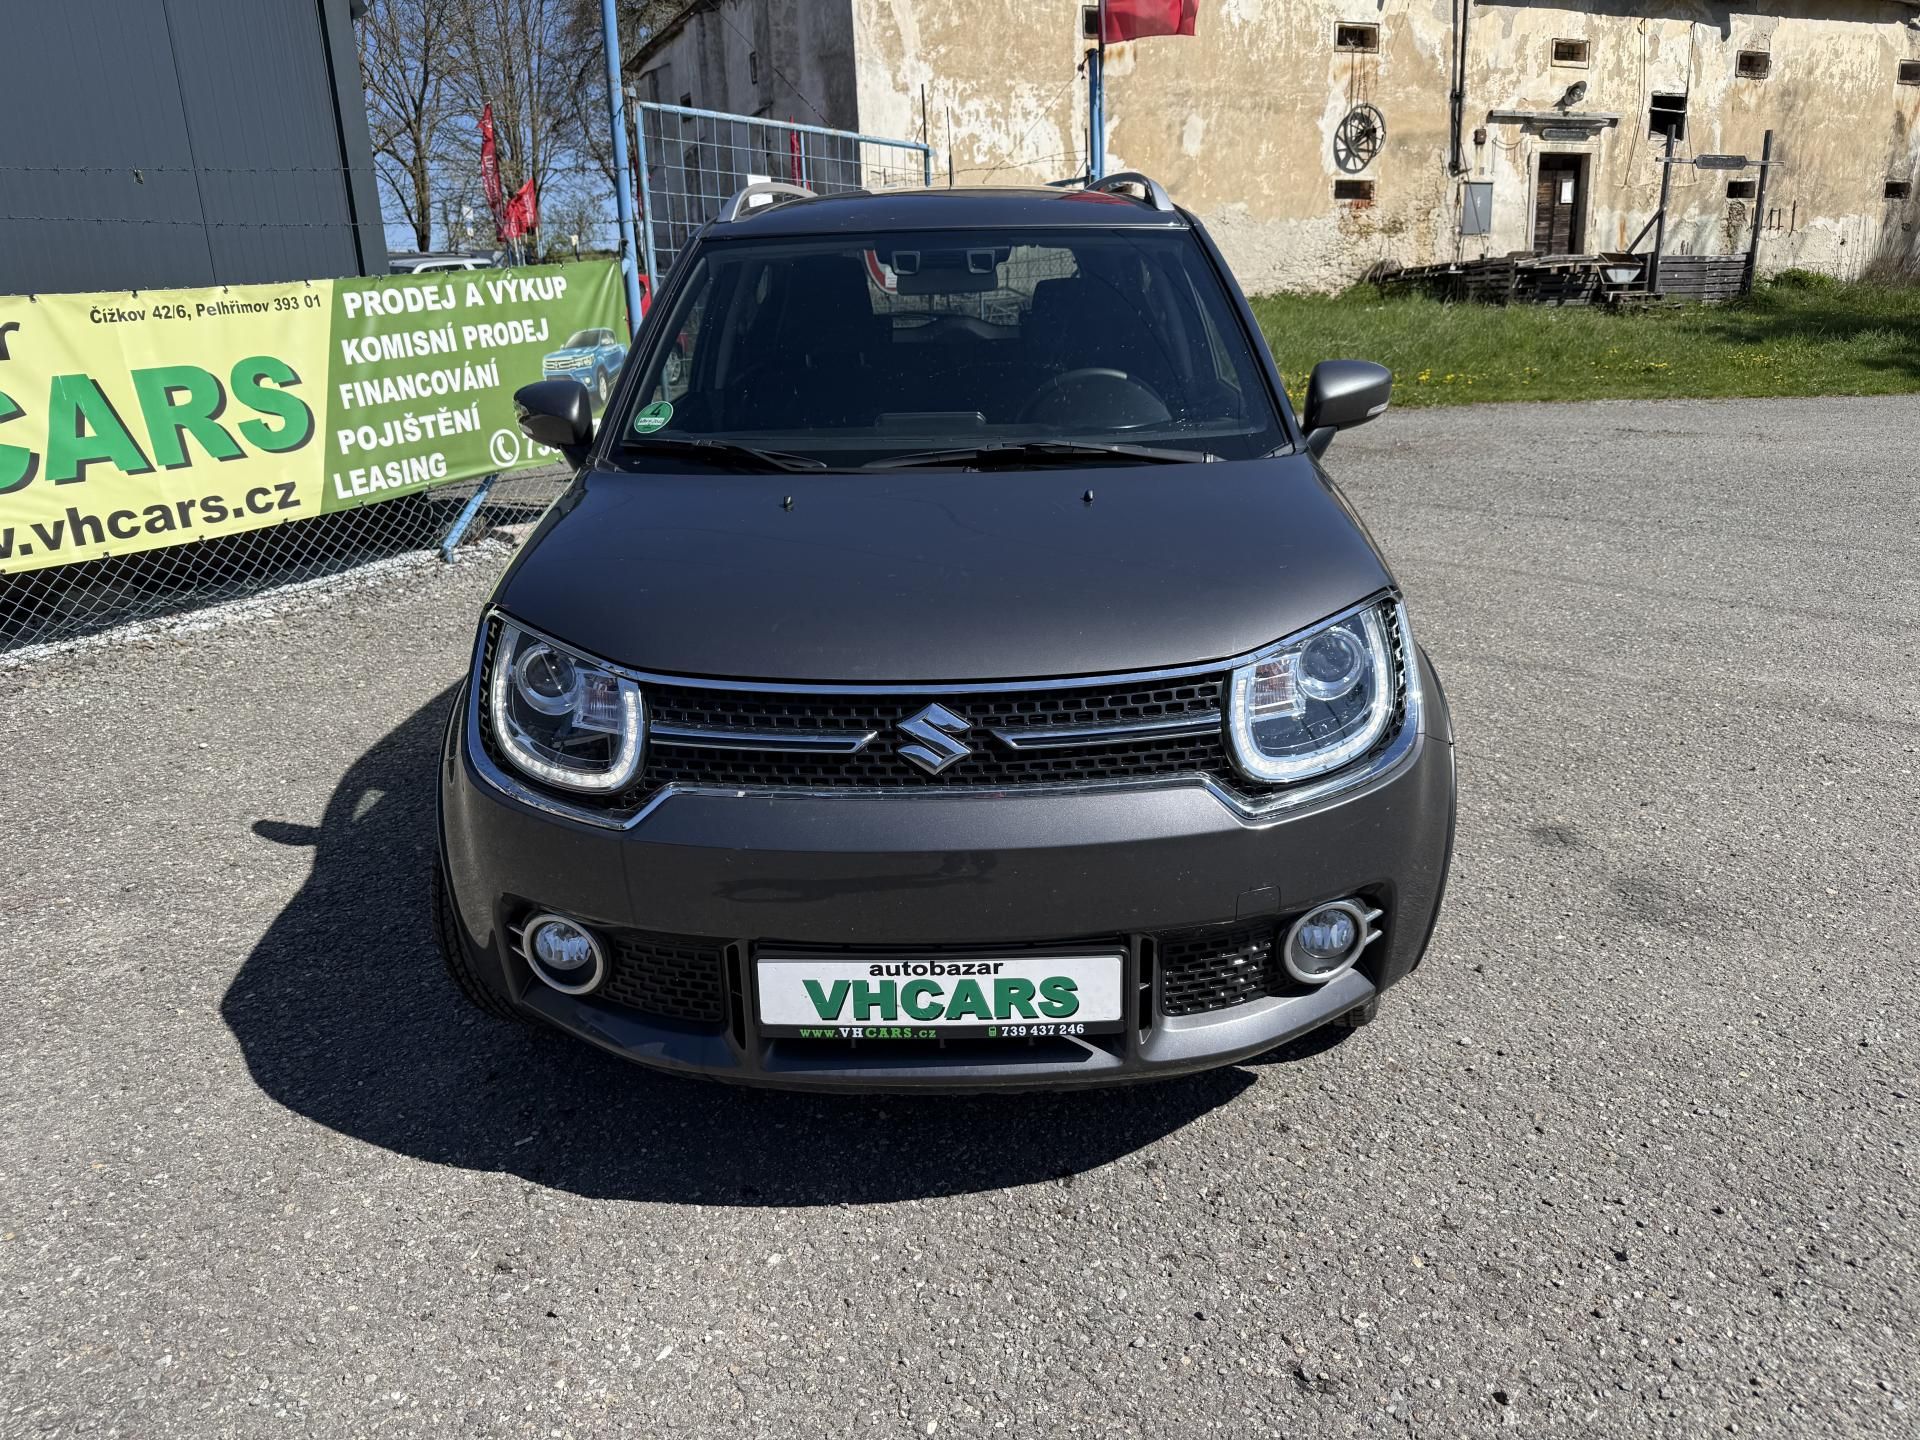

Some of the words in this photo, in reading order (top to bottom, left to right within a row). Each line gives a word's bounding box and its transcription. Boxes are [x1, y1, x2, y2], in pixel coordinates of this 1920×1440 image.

[89, 305, 147, 324] Čížkov
[152, 302, 192, 321] 42/6,
[196, 300, 270, 317] Pelhřimov
[274, 296, 300, 311] 393
[304, 293, 322, 308] 01
[342, 284, 456, 319] PRODEJ
[465, 283, 485, 307] A
[487, 273, 567, 305] VÝKUP
[341, 322, 458, 365] KOMISNÍ
[461, 317, 549, 350] PRODEJ
[339, 357, 500, 410] FINANCOVÁNÍ
[337, 401, 481, 455] POJIŠTĚNÍ
[333, 452, 448, 500] LEASING
[869, 960, 1004, 977] autobazar
[802, 976, 1080, 1022] VHCARS
[800, 1027, 937, 1039] www.VHCARS.cz
[1001, 1026, 1027, 1037] 739
[1030, 1025, 1055, 1036] 437
[1059, 1024, 1085, 1035] 246
